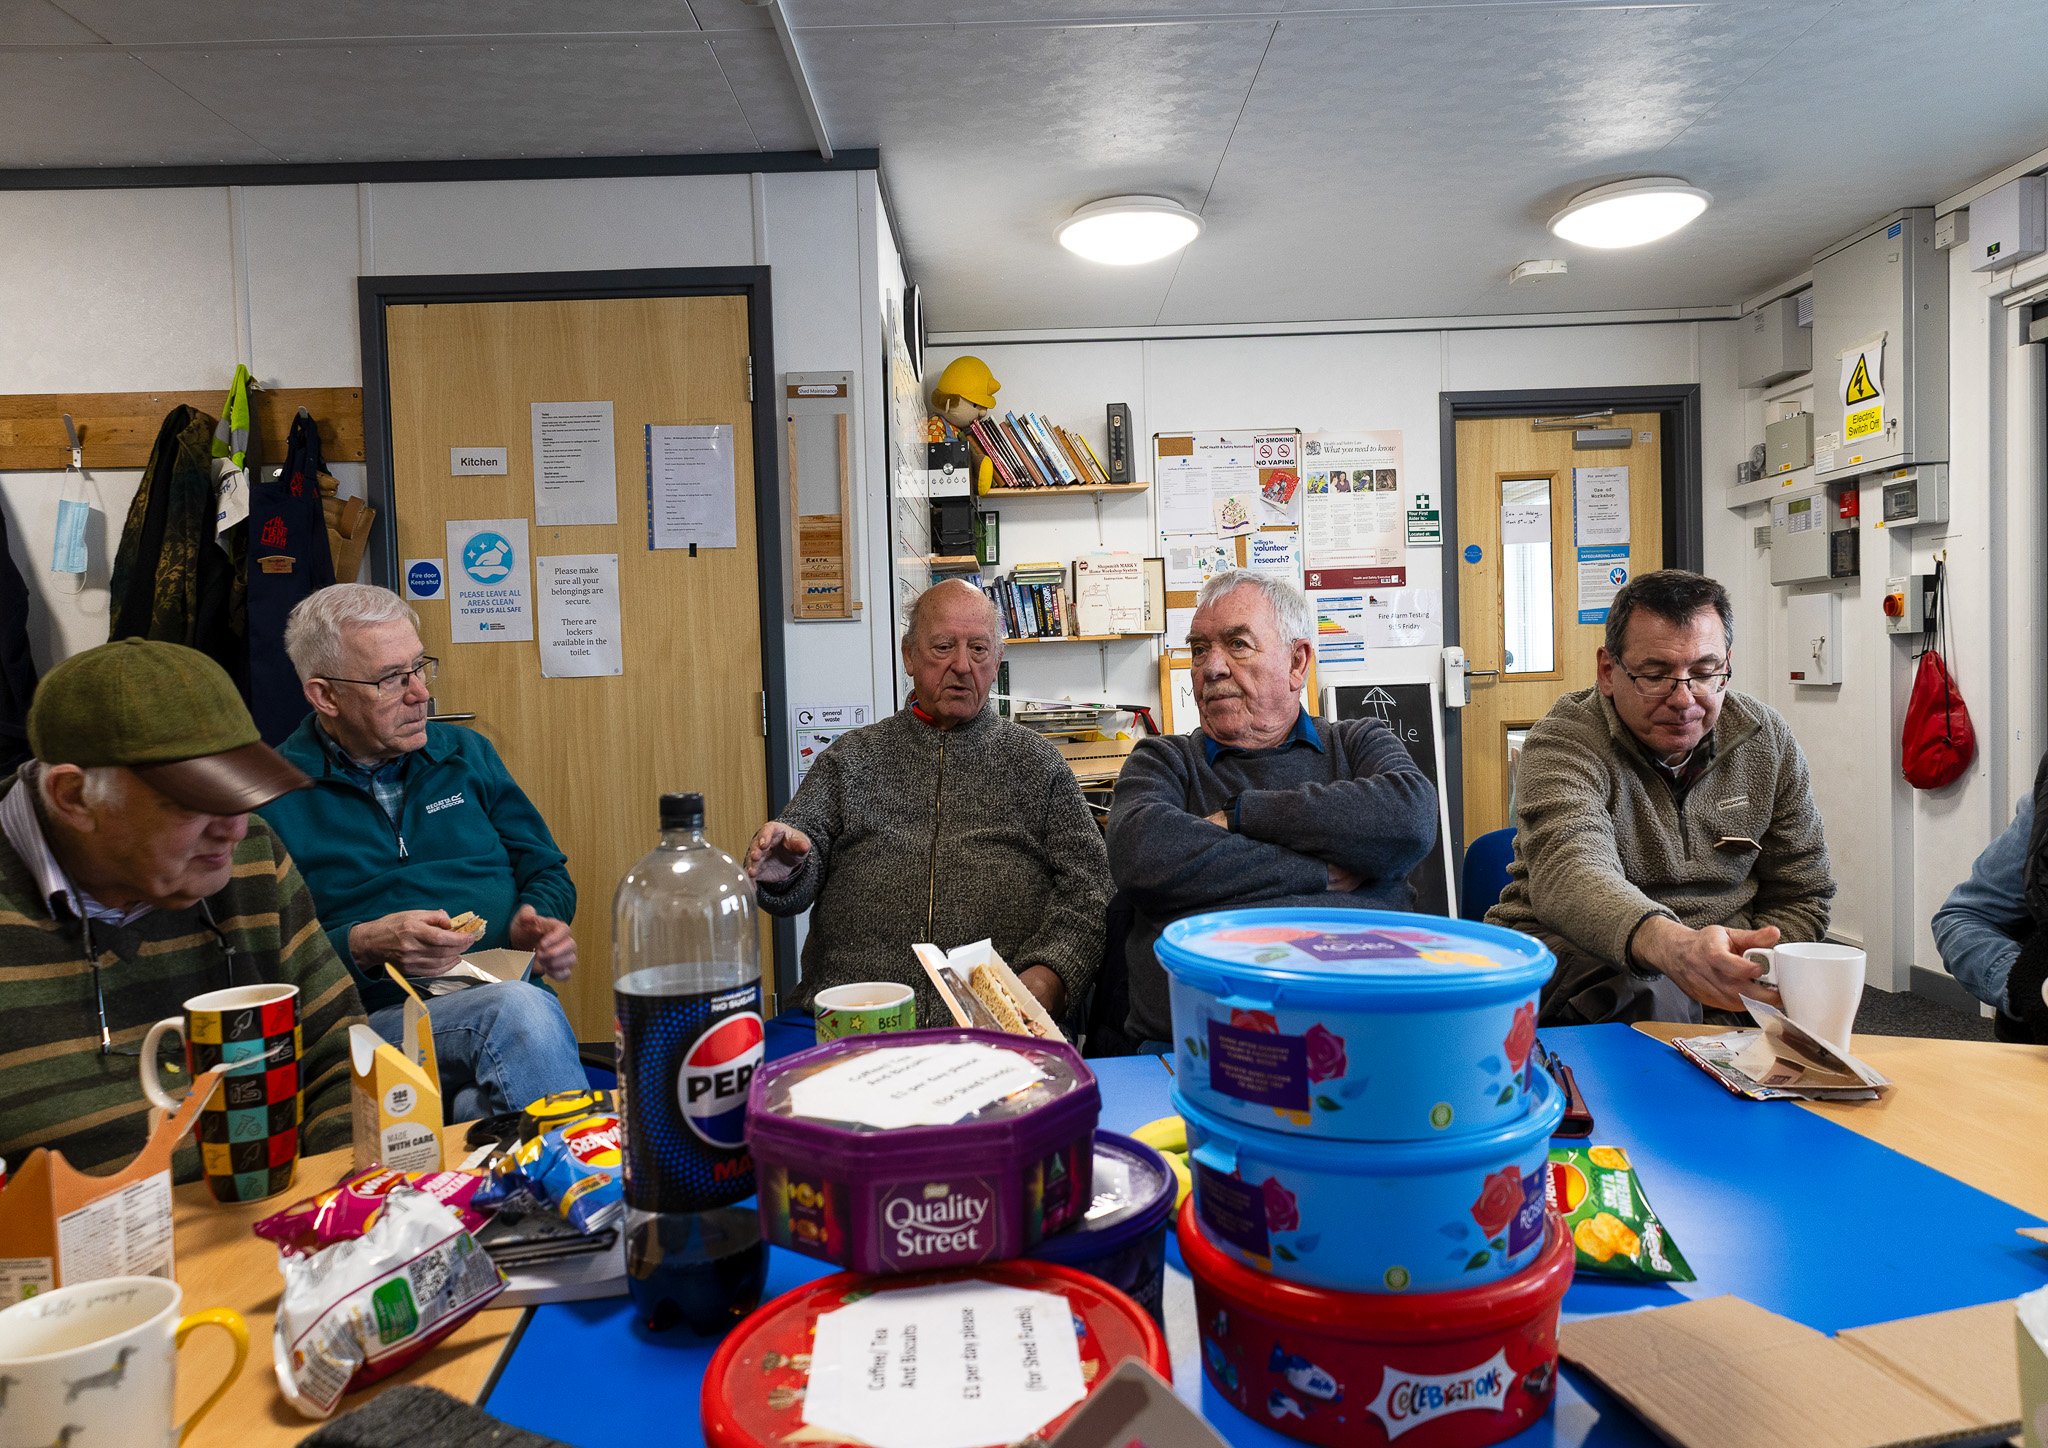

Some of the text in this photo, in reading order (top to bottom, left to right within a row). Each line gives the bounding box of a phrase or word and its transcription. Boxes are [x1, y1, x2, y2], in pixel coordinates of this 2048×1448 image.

[1853, 411, 1875, 424] Electric
[1849, 424, 1868, 436] Switch
[460, 457, 498, 467] Kitchen
[1254, 556, 1289, 564] research?
[554, 566, 599, 575] Please make
[572, 577, 581, 585] all
[582, 578, 599, 586] your
[551, 587, 591, 597] belongings
[807, 585, 843, 594] MATT
[561, 618, 584, 626] There
[566, 628, 593, 636] lockers
[552, 638, 585, 647] available
[570, 648, 591, 656] toilet.
[822, 709, 842, 717] general
[711, 1001, 729, 1012] NO
[878, 1014, 902, 1030] BEST
[388, 1133, 434, 1152] WITH CARE
[713, 1154, 751, 1182] MA
[885, 1193, 989, 1230] Quality
[896, 1227, 981, 1257] Street
